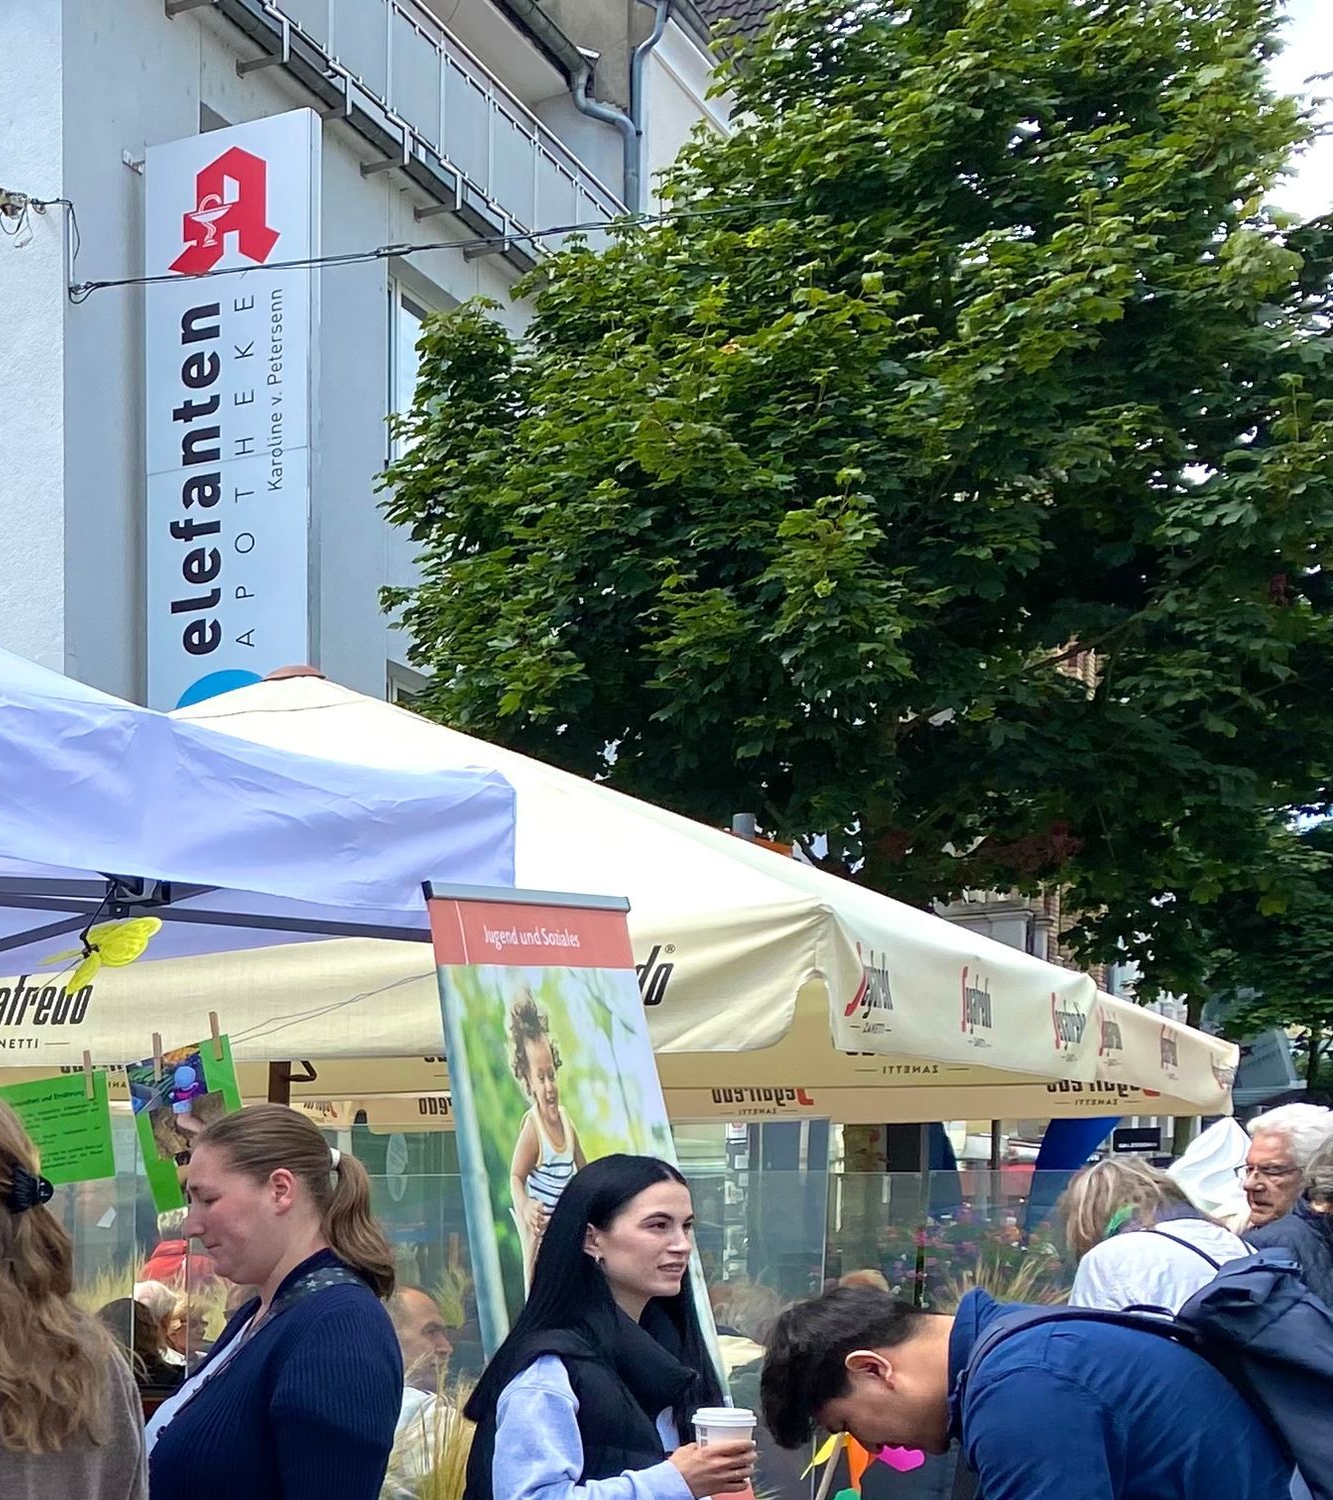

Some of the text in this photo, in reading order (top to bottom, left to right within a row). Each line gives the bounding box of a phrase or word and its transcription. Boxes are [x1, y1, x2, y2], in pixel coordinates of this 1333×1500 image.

[170, 301, 222, 656] elefanten
[234, 294, 256, 648] APOTHEKE
[266, 288, 283, 491] Karoline v. Petersenn
[484, 924, 581, 950] Jugend und Soziales
